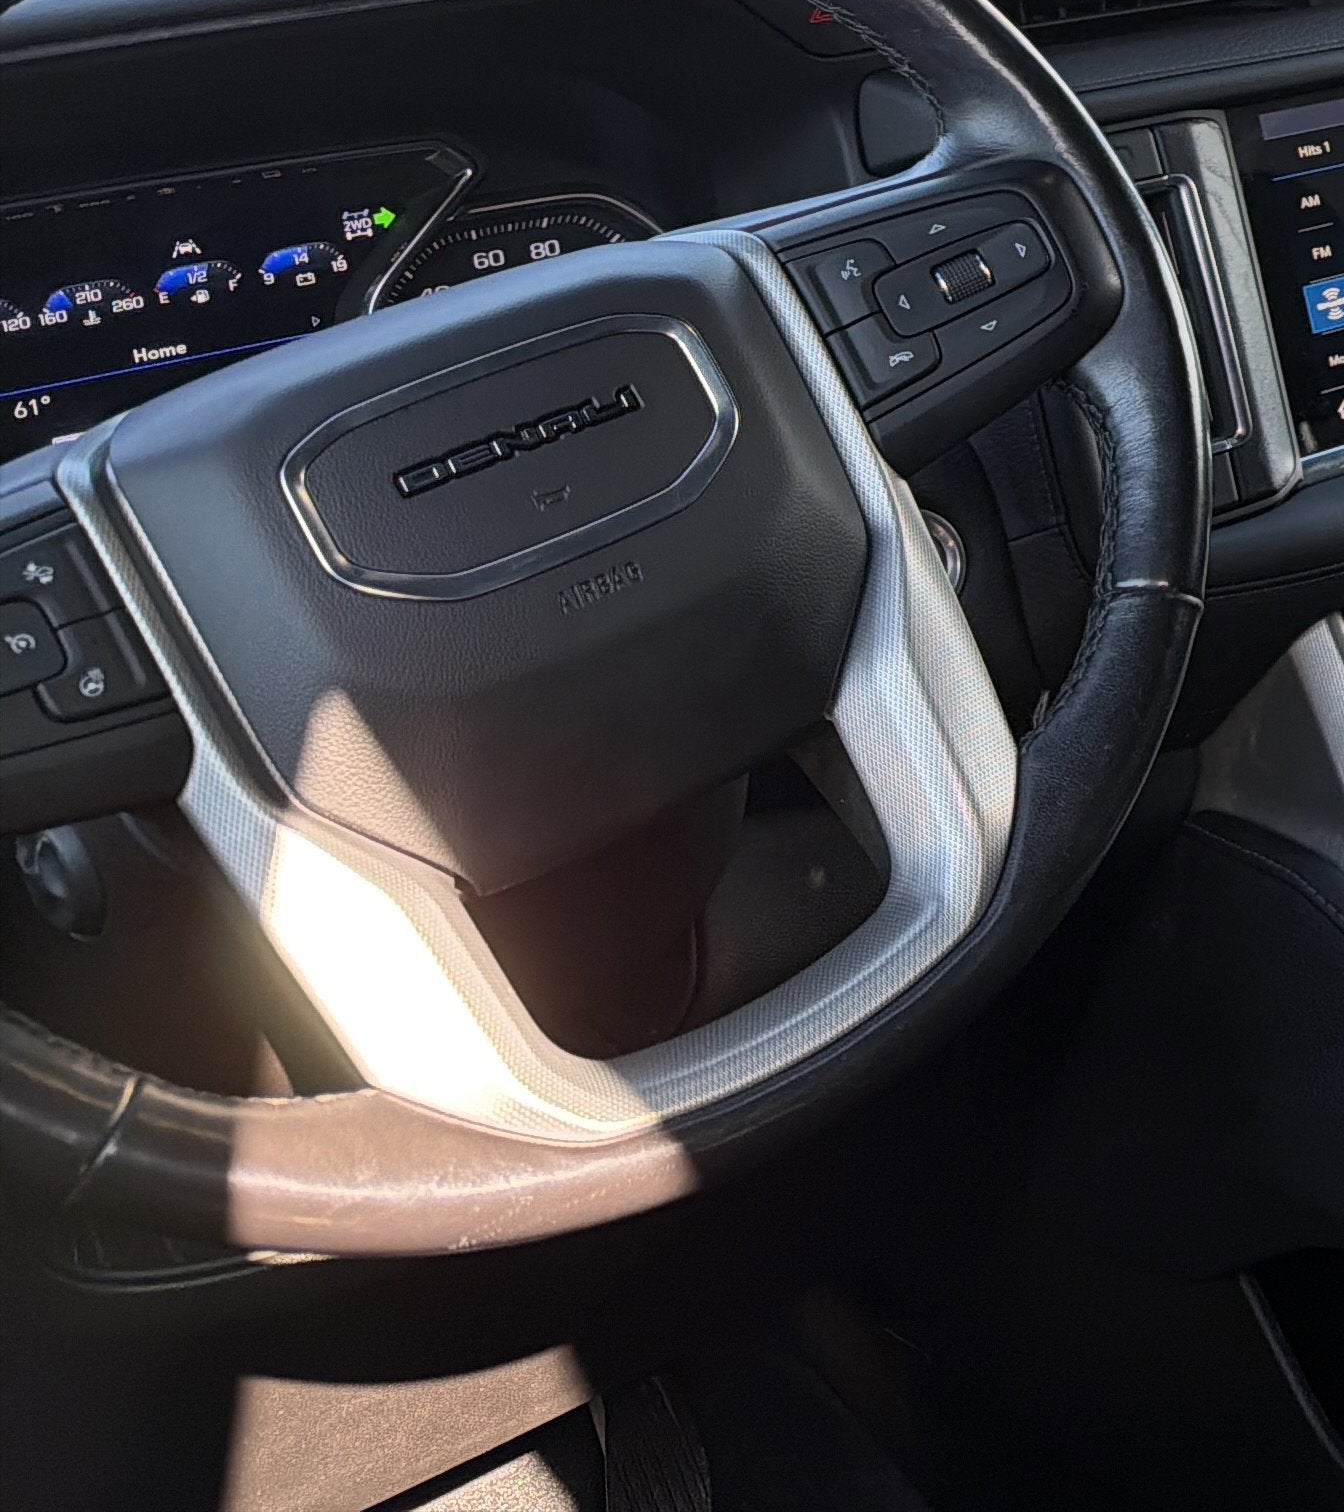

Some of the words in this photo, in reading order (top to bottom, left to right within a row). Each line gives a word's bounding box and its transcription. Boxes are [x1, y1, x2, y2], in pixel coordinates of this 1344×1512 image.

[1298, 143, 1322, 159] Hits
[1300, 194, 1321, 209] AM
[343, 216, 373, 233] 2WD
[292, 249, 310, 265] 14
[529, 239, 562, 261] 80
[1311, 245, 1332, 261] FM
[331, 257, 348, 273] 19
[472, 249, 506, 271] 60
[186, 267, 208, 285] 1/2
[228, 275, 241, 292] F
[263, 271, 275, 286] 9
[75, 287, 103, 306] 210
[111, 294, 145, 314] 260
[158, 290, 171, 306] E
[0, 313, 32, 333] 120
[38, 308, 68, 328] 160
[132, 340, 188, 364] Home
[12, 395, 52, 421] 61°
[394, 382, 646, 499] DENALI
[556, 560, 645, 615] AIRBAG
